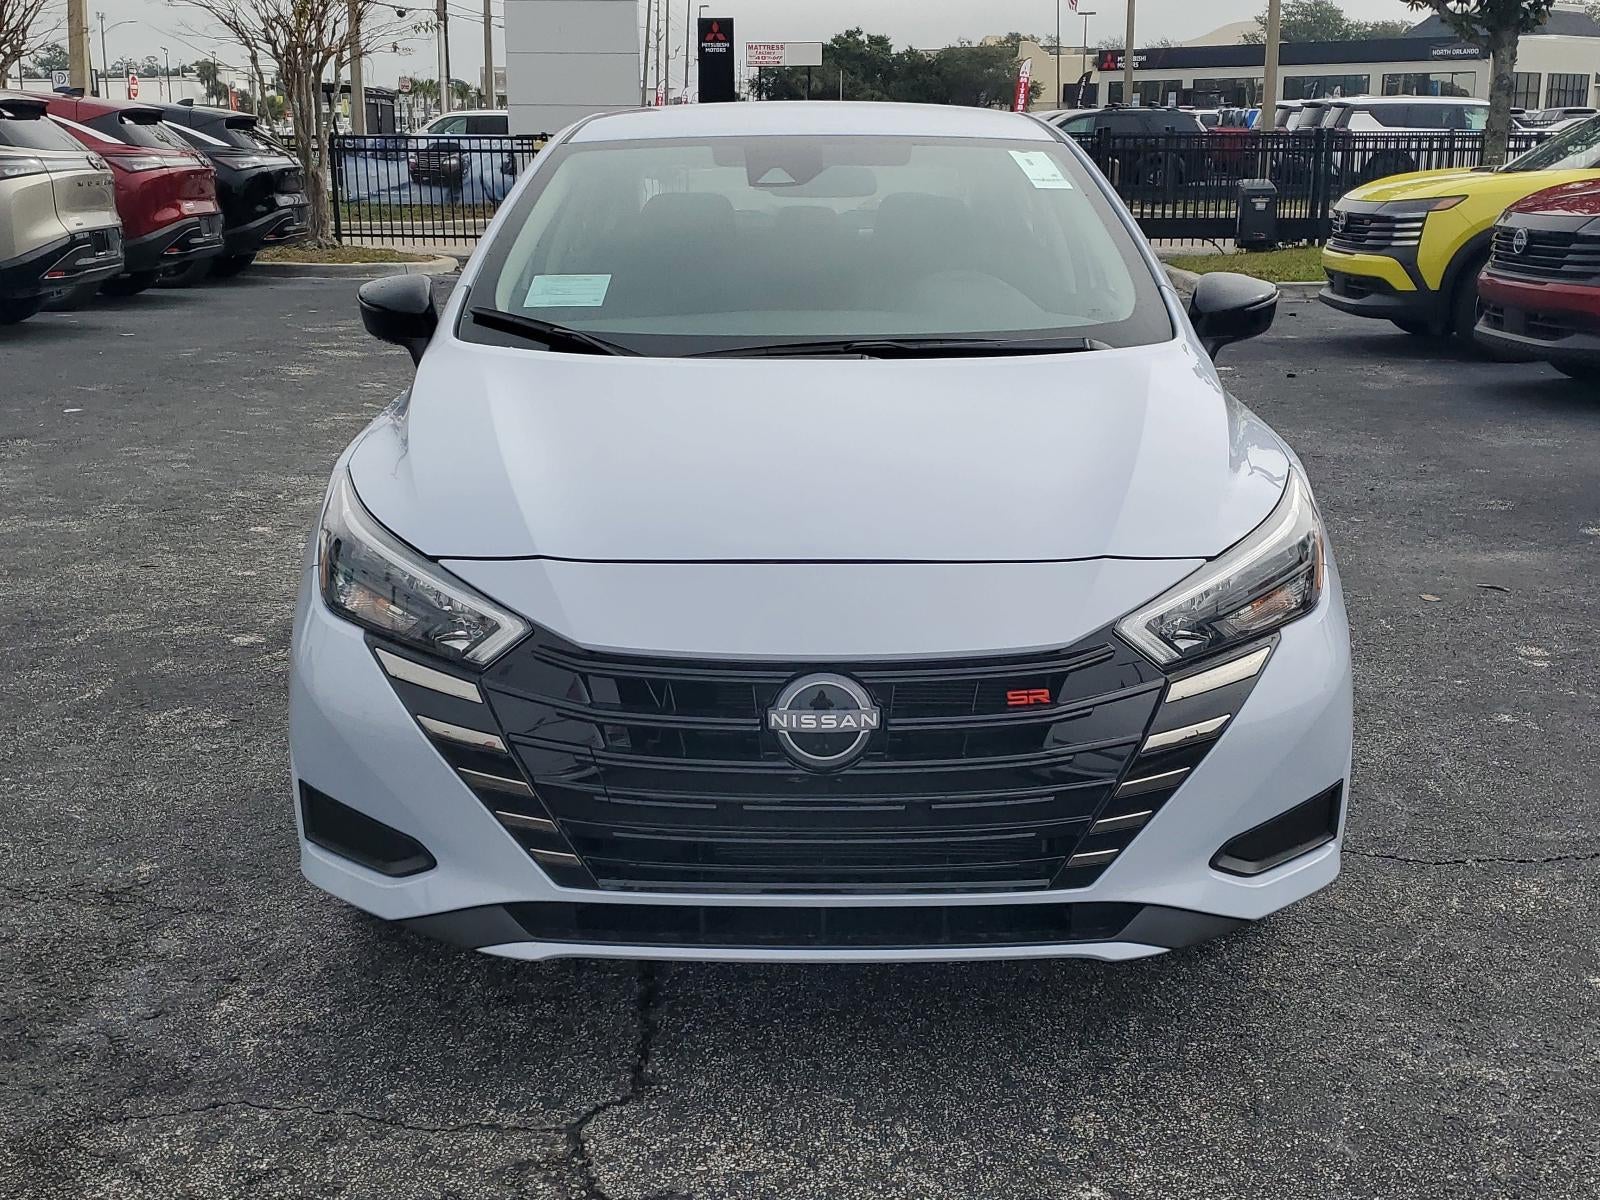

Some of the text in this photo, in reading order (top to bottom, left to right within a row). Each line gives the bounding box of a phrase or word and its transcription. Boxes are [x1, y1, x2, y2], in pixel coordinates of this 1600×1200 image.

[1017, 77, 1028, 112] MITSUB
[1007, 688, 1050, 706] SR
[771, 713, 878, 729] NISSAN
